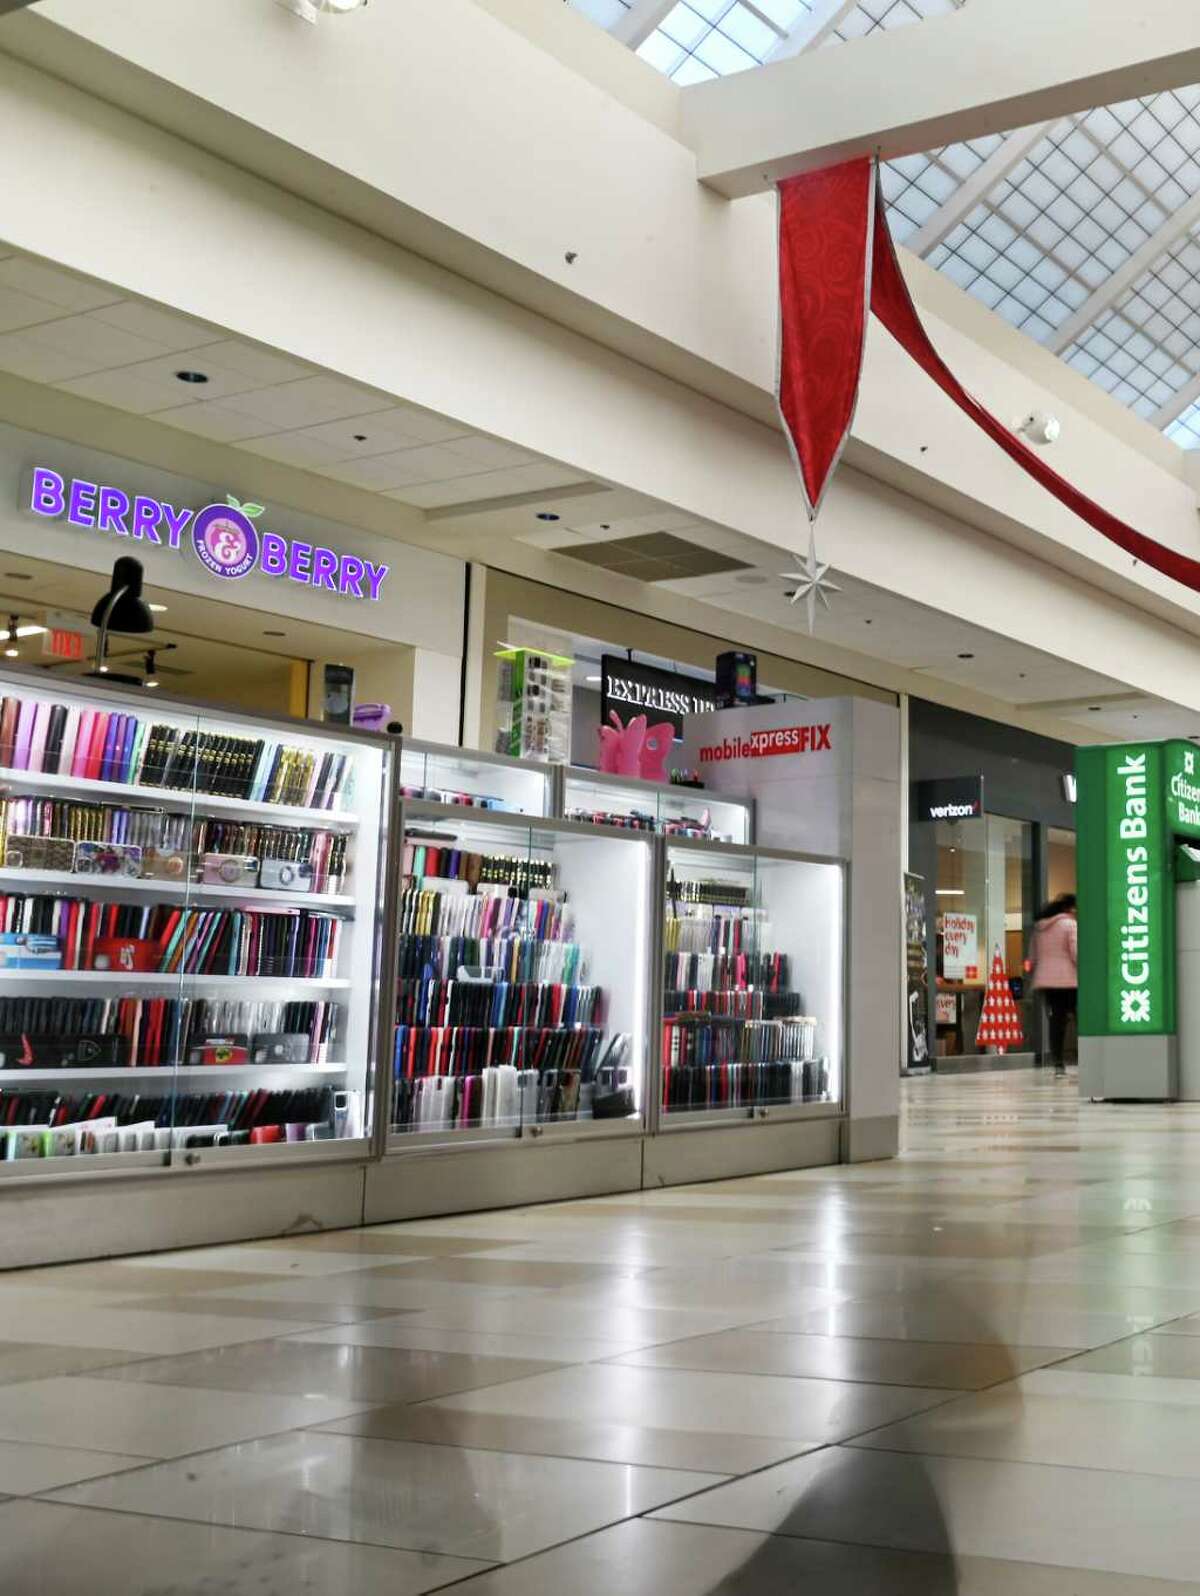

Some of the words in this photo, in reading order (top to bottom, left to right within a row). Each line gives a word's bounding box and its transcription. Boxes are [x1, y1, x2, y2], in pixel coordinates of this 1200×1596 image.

[31, 467, 193, 549] BERRY
[261, 532, 389, 601] BERRY
[196, 539, 223, 573] FROZEN
[225, 552, 254, 575] YOGURT
[606, 675, 689, 715] EXPRESS
[929, 803, 974, 819] verizon
[1117, 752, 1148, 839] Bank
[1121, 846, 1151, 985] Citizens
